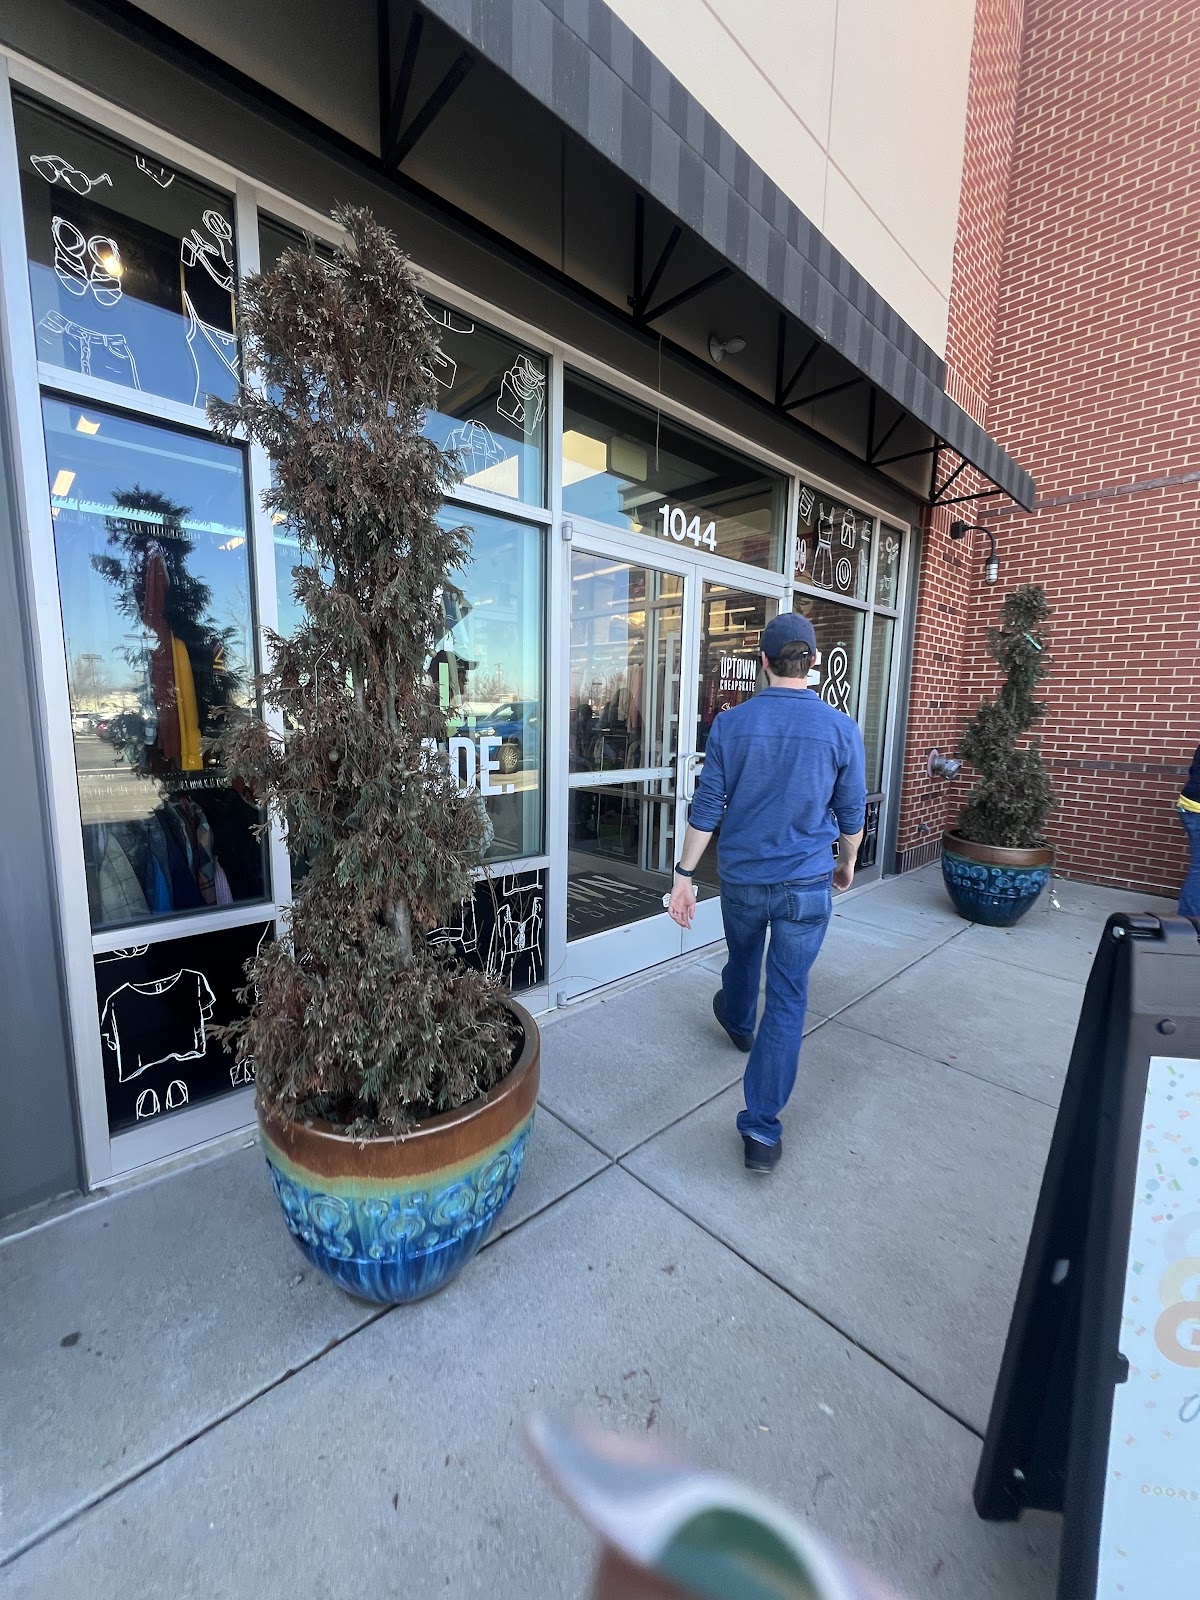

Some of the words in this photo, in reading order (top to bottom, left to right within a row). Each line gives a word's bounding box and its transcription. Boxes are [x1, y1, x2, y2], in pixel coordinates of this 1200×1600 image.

[658, 503, 717, 552] 1044
[720, 656, 756, 681] UPTOWN
[720, 679, 756, 692] CHEAPSKATE
[568, 875, 639, 903] WN
